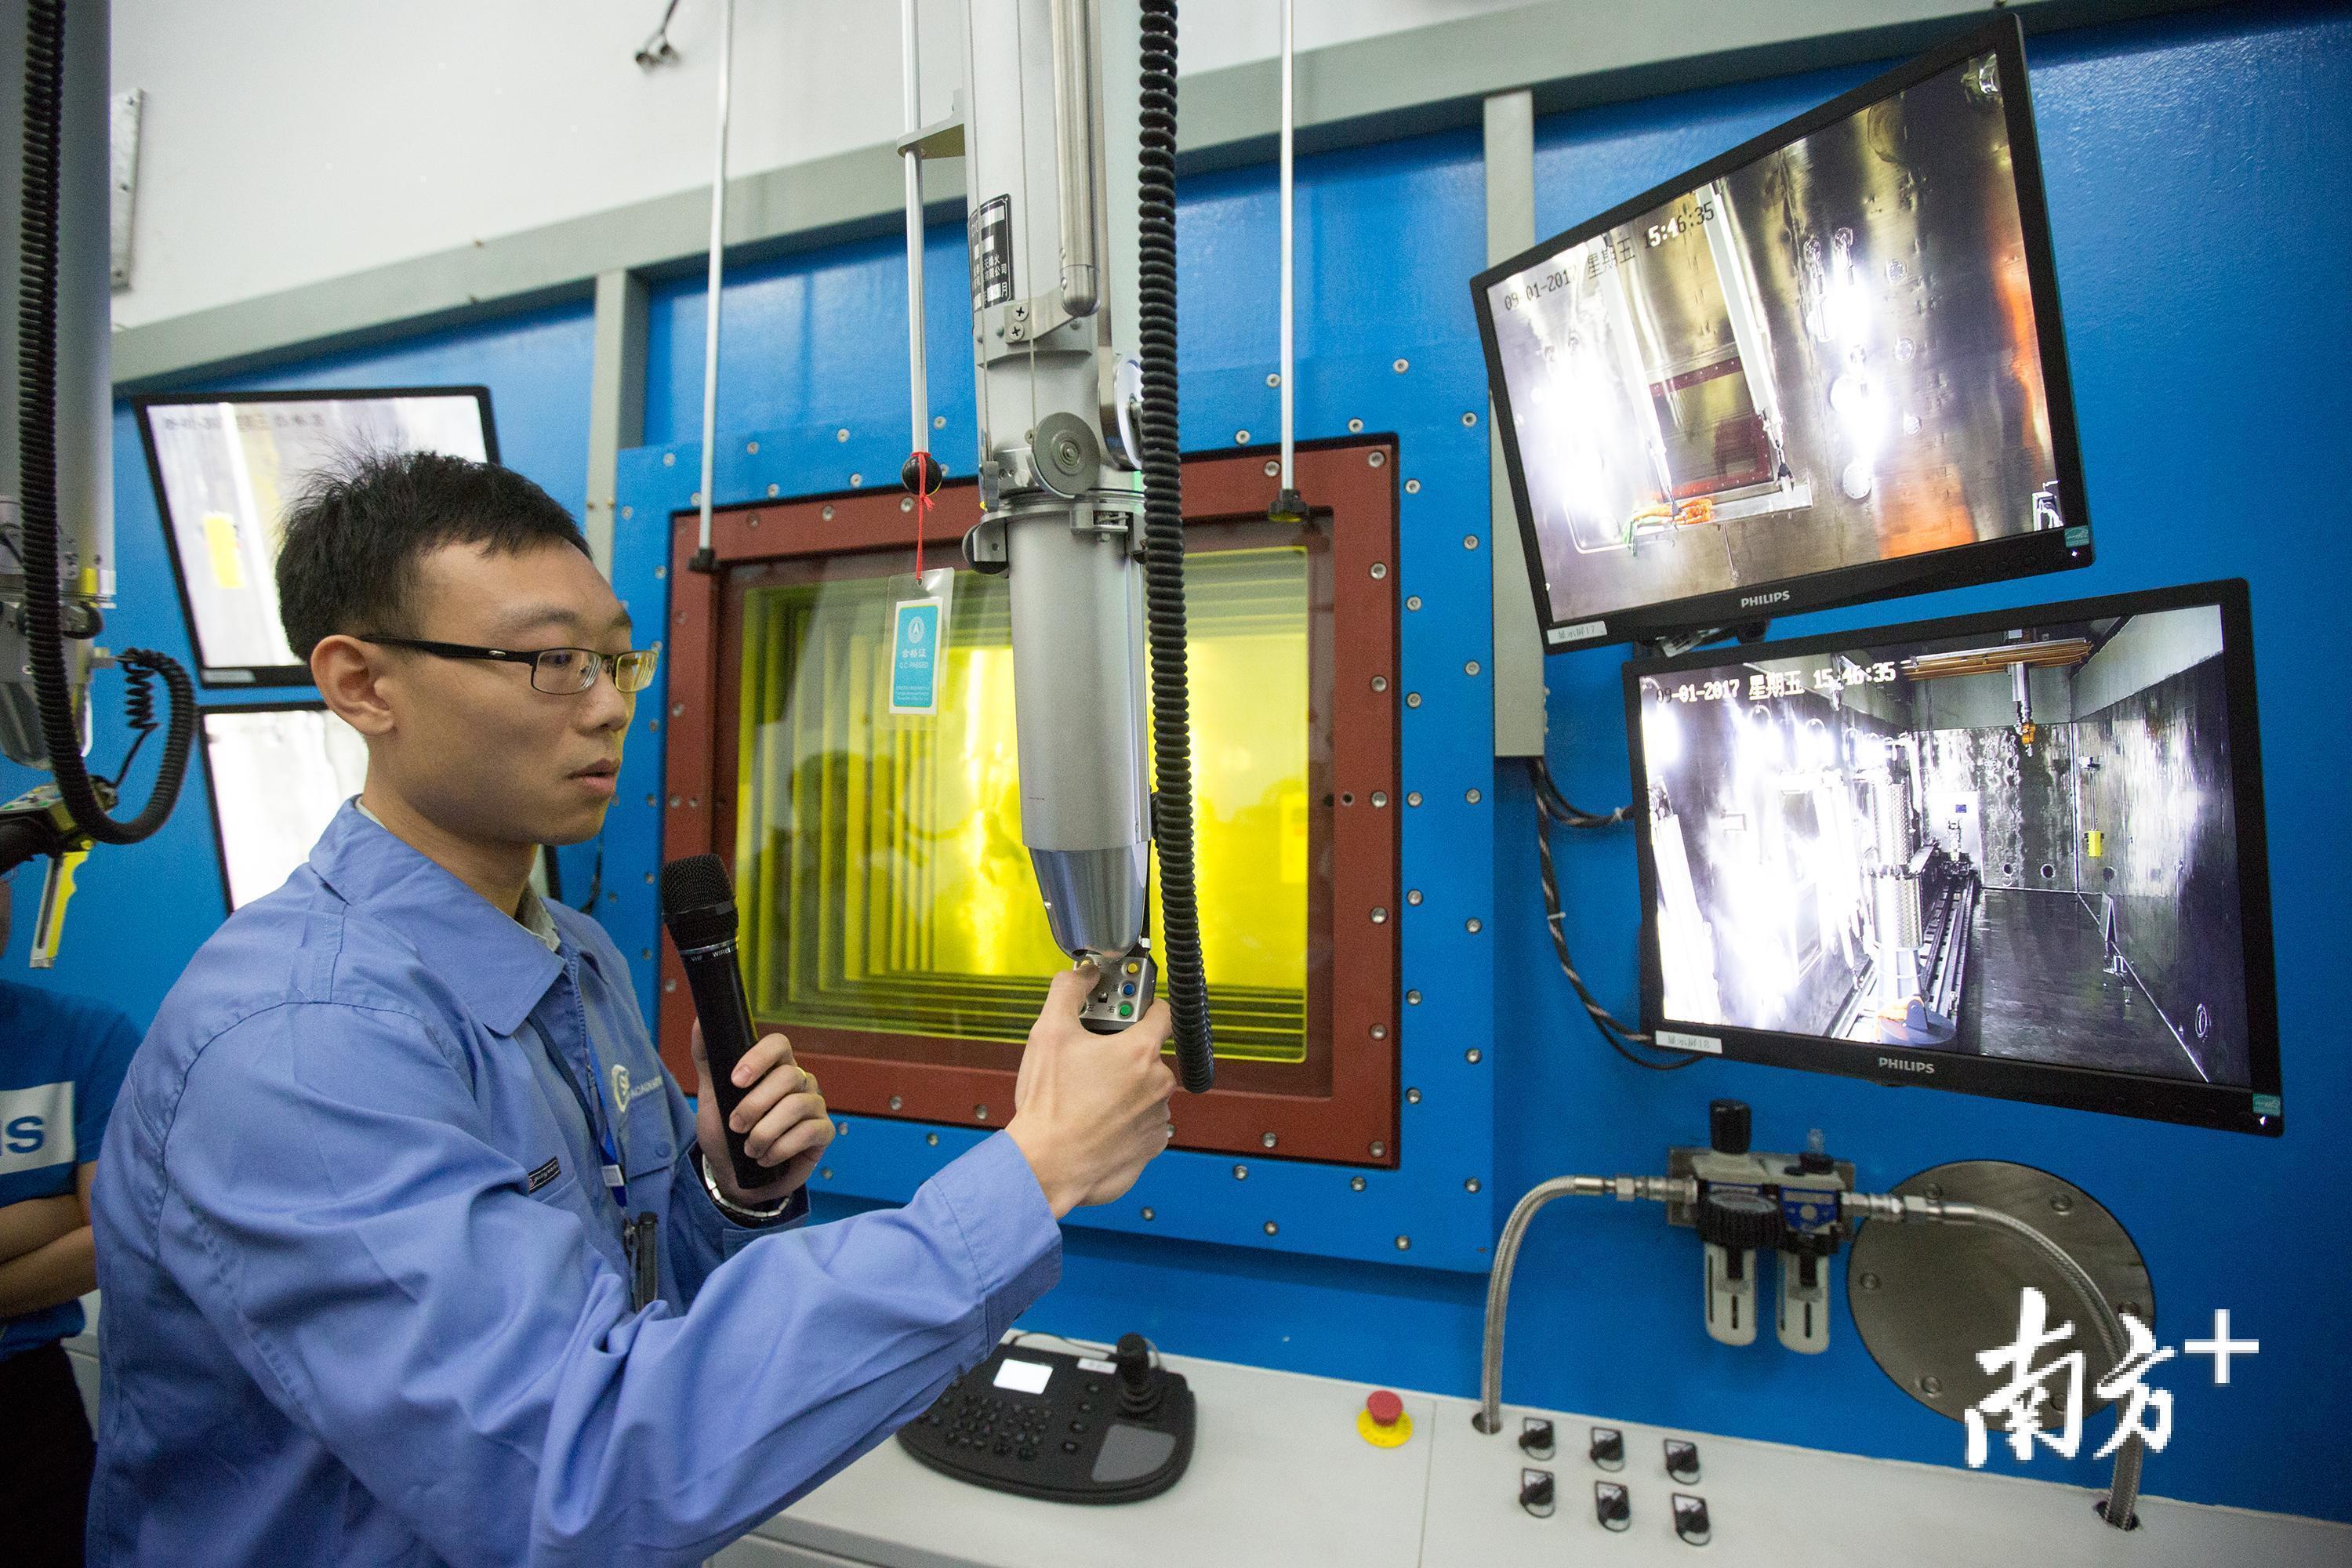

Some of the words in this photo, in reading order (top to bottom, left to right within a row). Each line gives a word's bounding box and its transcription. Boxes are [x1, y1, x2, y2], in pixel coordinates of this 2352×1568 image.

[1587, 237, 1636, 280] 星期五
[1740, 590, 1791, 608] PHILIPS
[902, 648, 927, 659] 合格证
[1656, 678, 1740, 704] 09-01-2017
[1749, 670, 1805, 701] 星期五
[1813, 661, 1896, 689] 15:46:35
[1878, 1057, 1936, 1074] PHILIPS
